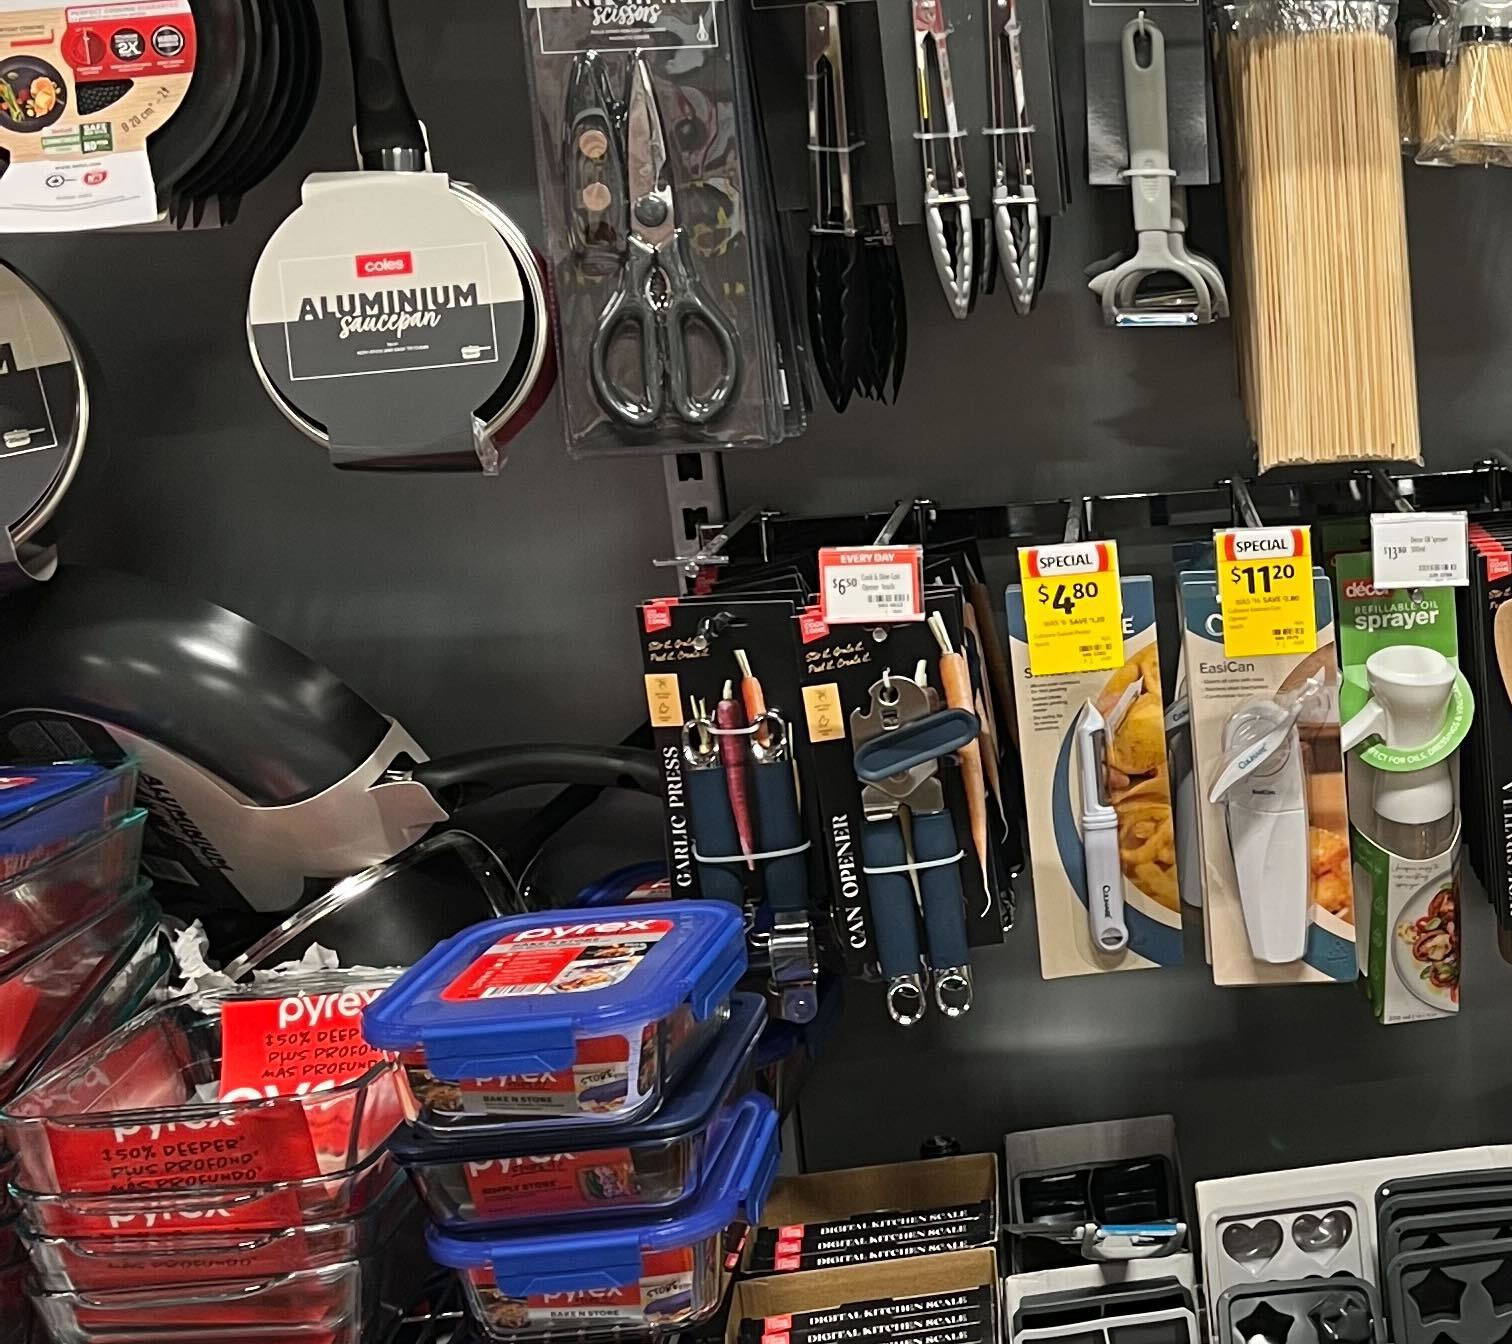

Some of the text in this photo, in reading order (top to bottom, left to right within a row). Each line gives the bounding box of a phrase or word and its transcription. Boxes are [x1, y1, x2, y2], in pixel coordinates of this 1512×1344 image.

[592, 1, 662, 29] scissors
[364, 257, 405, 274] coles
[298, 284, 478, 323] ALUMINIUM
[338, 306, 442, 340] saucepan
[1236, 538, 1289, 553] SPECIAL
[1039, 555, 1094, 569] SPECIAL
[1420, 599, 1439, 610] OIL
[1354, 607, 1439, 633] sprayer
[1200, 660, 1255, 674] EasiCan
[663, 746, 692, 887] GARLIC PRESS
[832, 813, 867, 949] CAN OPENER
[514, 918, 658, 941] pyrex
